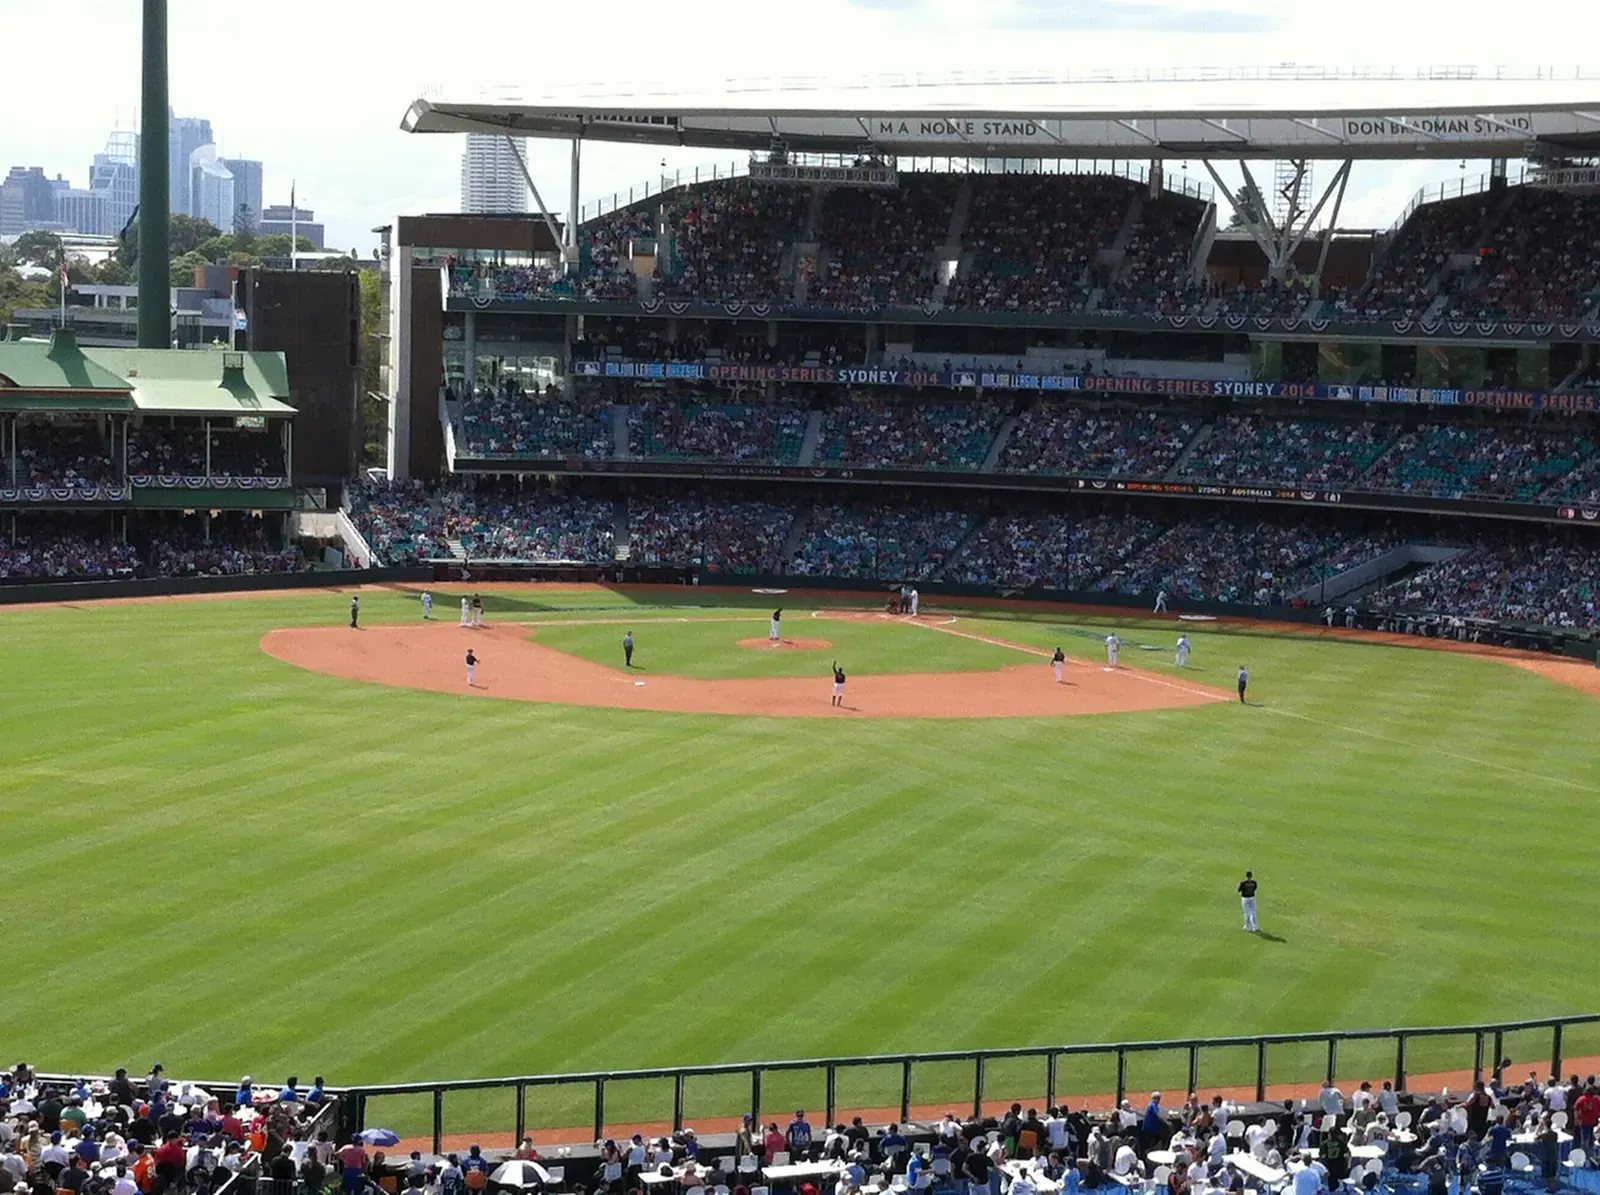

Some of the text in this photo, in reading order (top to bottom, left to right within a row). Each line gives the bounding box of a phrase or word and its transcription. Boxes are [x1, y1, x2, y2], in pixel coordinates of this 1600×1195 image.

[880, 122, 893, 134] M
[898, 122, 909, 134] A
[983, 122, 1037, 136] STAND
[1348, 121, 1385, 135] DON
[709, 366, 938, 385] OPENING SERIES SYDNEY 2014
[1085, 377, 1316, 397] OPENING SERIES SYDNEY 2014
[1465, 390, 1594, 409] OPENING SERIES
